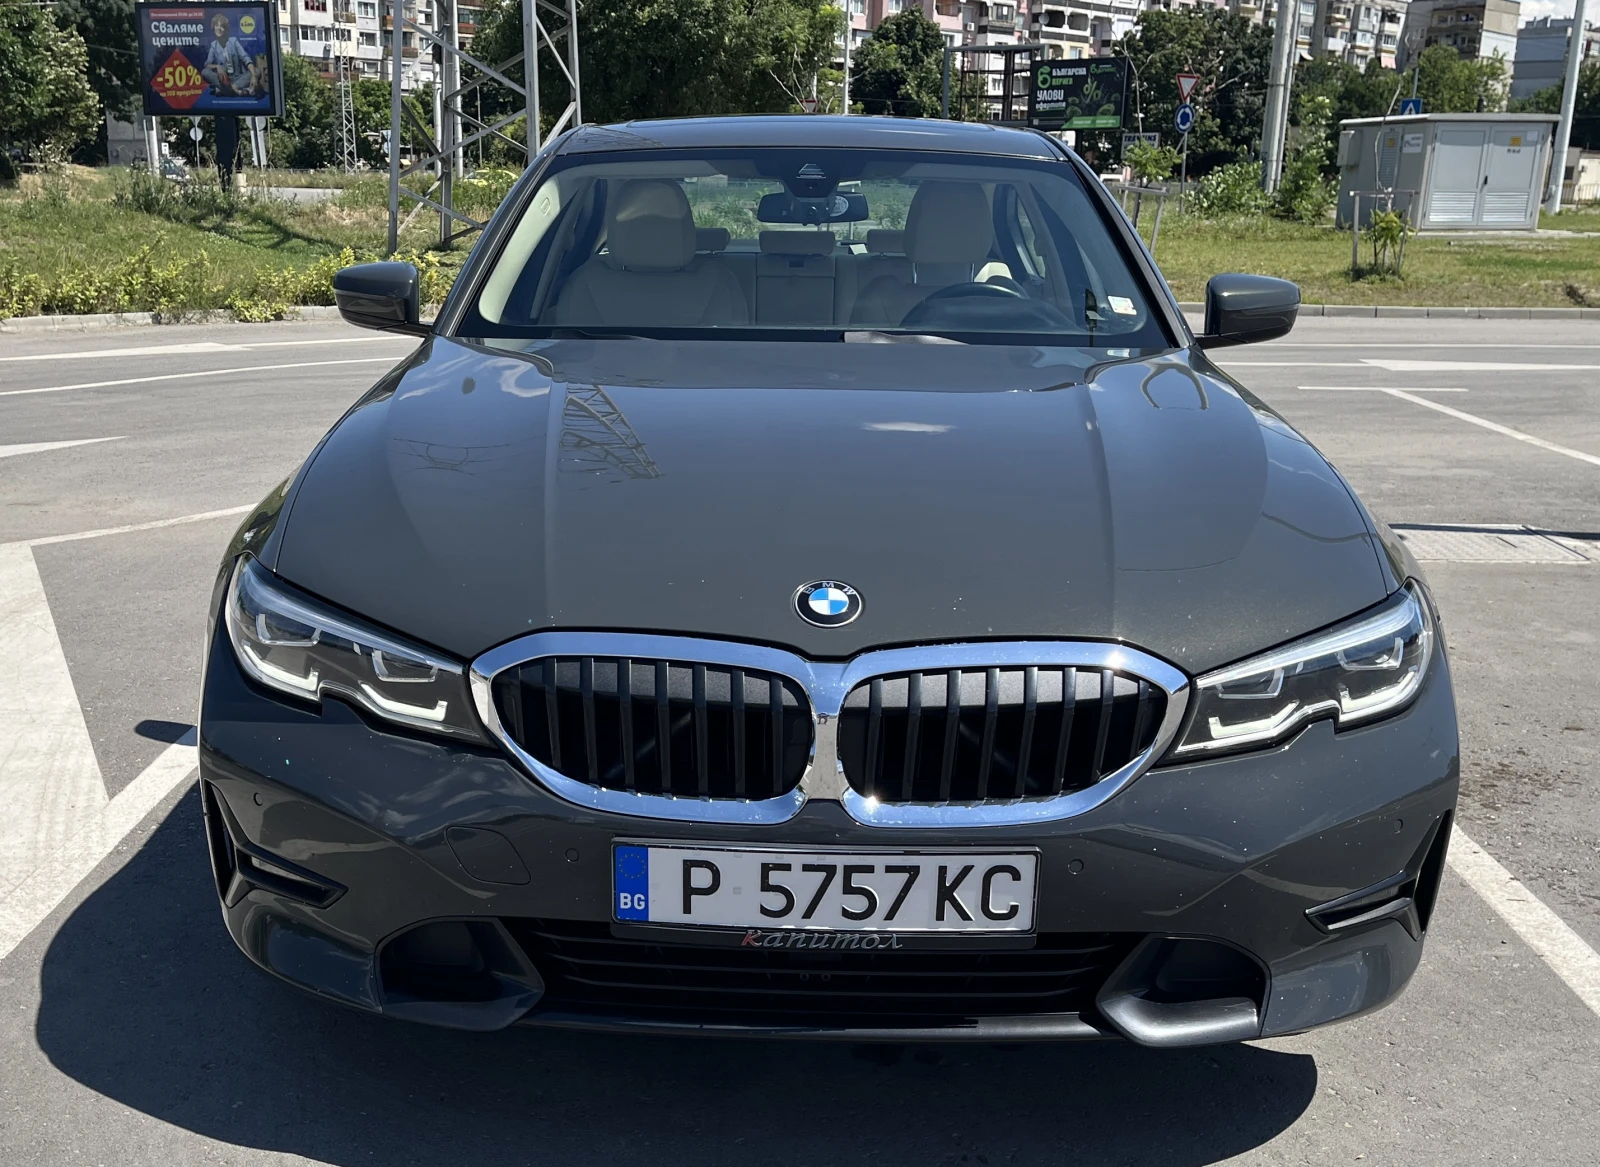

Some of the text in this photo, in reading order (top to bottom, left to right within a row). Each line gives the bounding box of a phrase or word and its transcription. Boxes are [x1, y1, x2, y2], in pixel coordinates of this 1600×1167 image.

[151, 21, 204, 33] Сваляме
[152, 36, 200, 47] цените
[156, 65, 202, 88] -50%
[1036, 89, 1064, 101] УЛОВИ
[802, 581, 857, 595] BMW
[681, 858, 1023, 922] P 5757 KC
[619, 891, 646, 910] BG
[741, 929, 904, 949] Капитол
